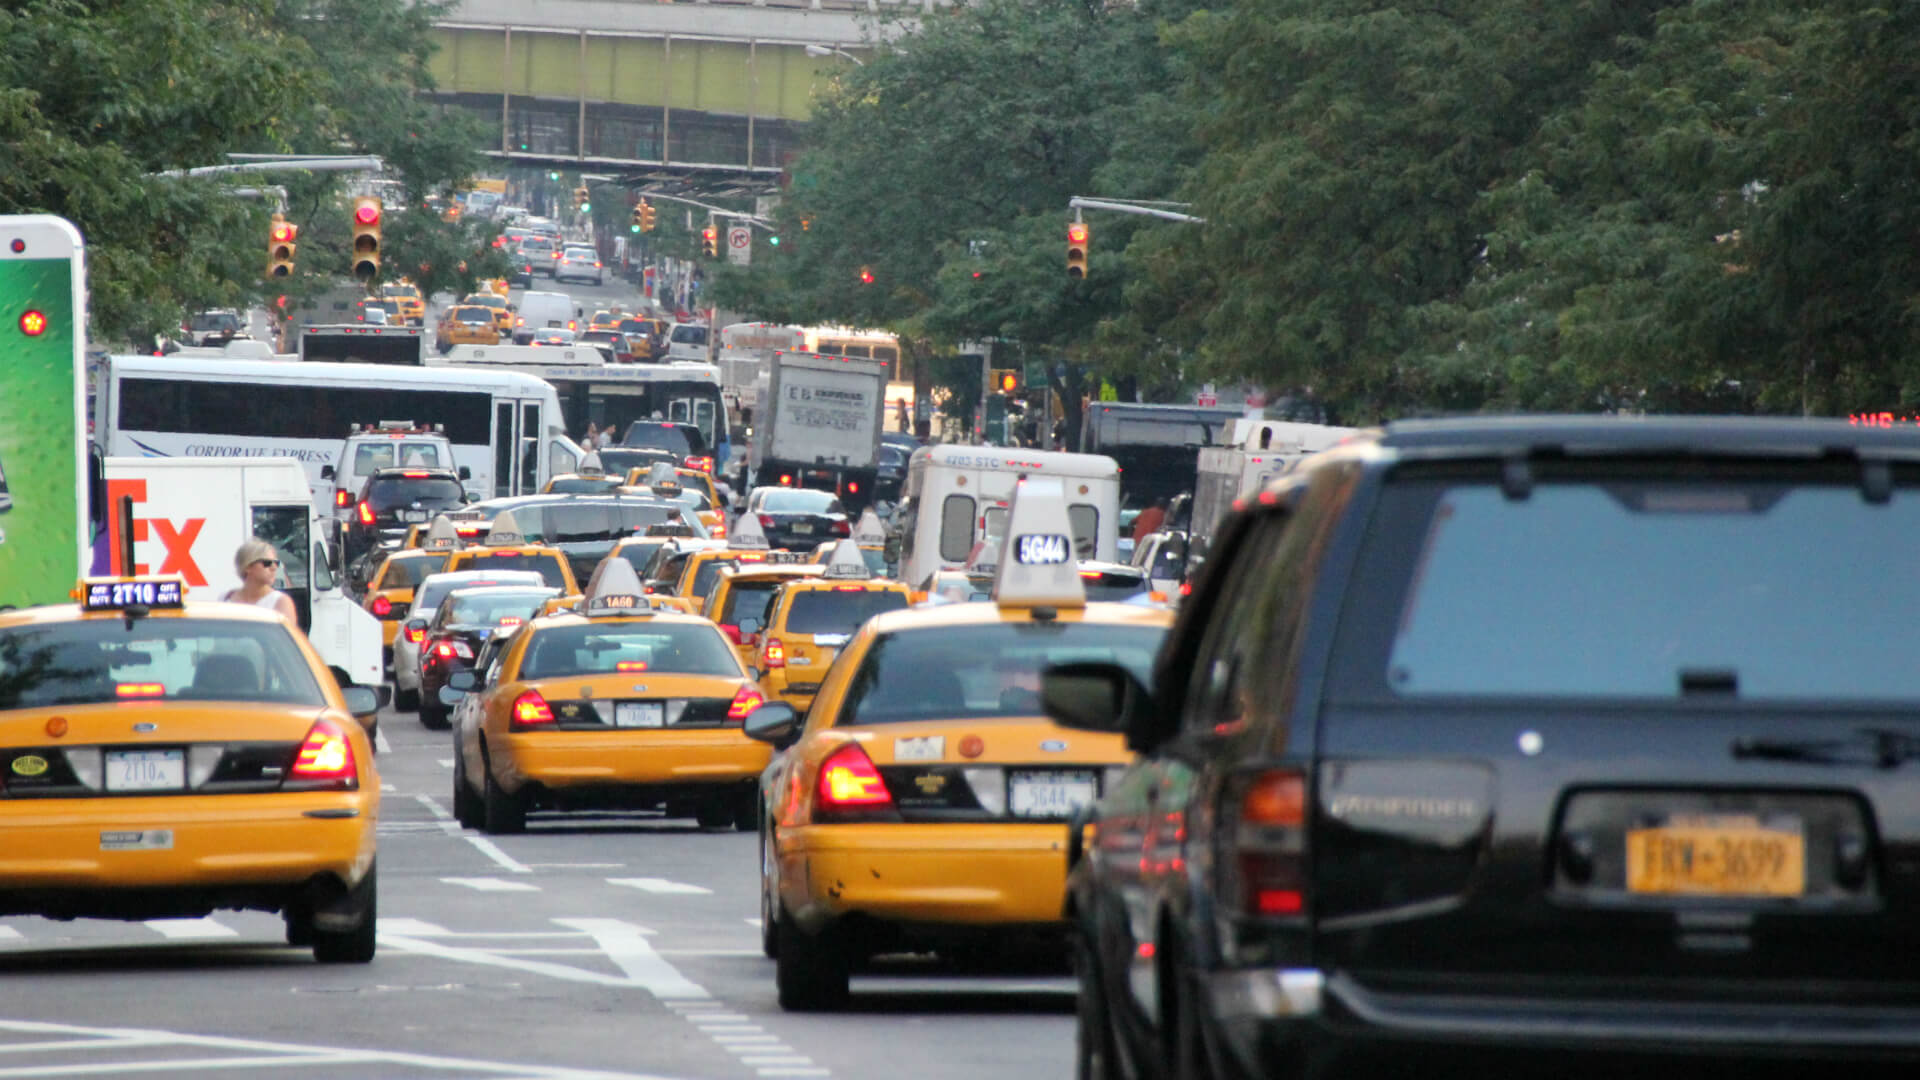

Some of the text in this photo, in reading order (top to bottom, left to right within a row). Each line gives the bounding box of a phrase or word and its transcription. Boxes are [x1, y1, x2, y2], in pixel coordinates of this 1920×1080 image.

[184, 444, 334, 463] CORPORATE EXPRESS
[975, 456, 1000, 468] STC
[1020, 534, 1066, 564] 5G44
[113, 583, 153, 606] 2T10
[159, 583, 177, 592] OFF
